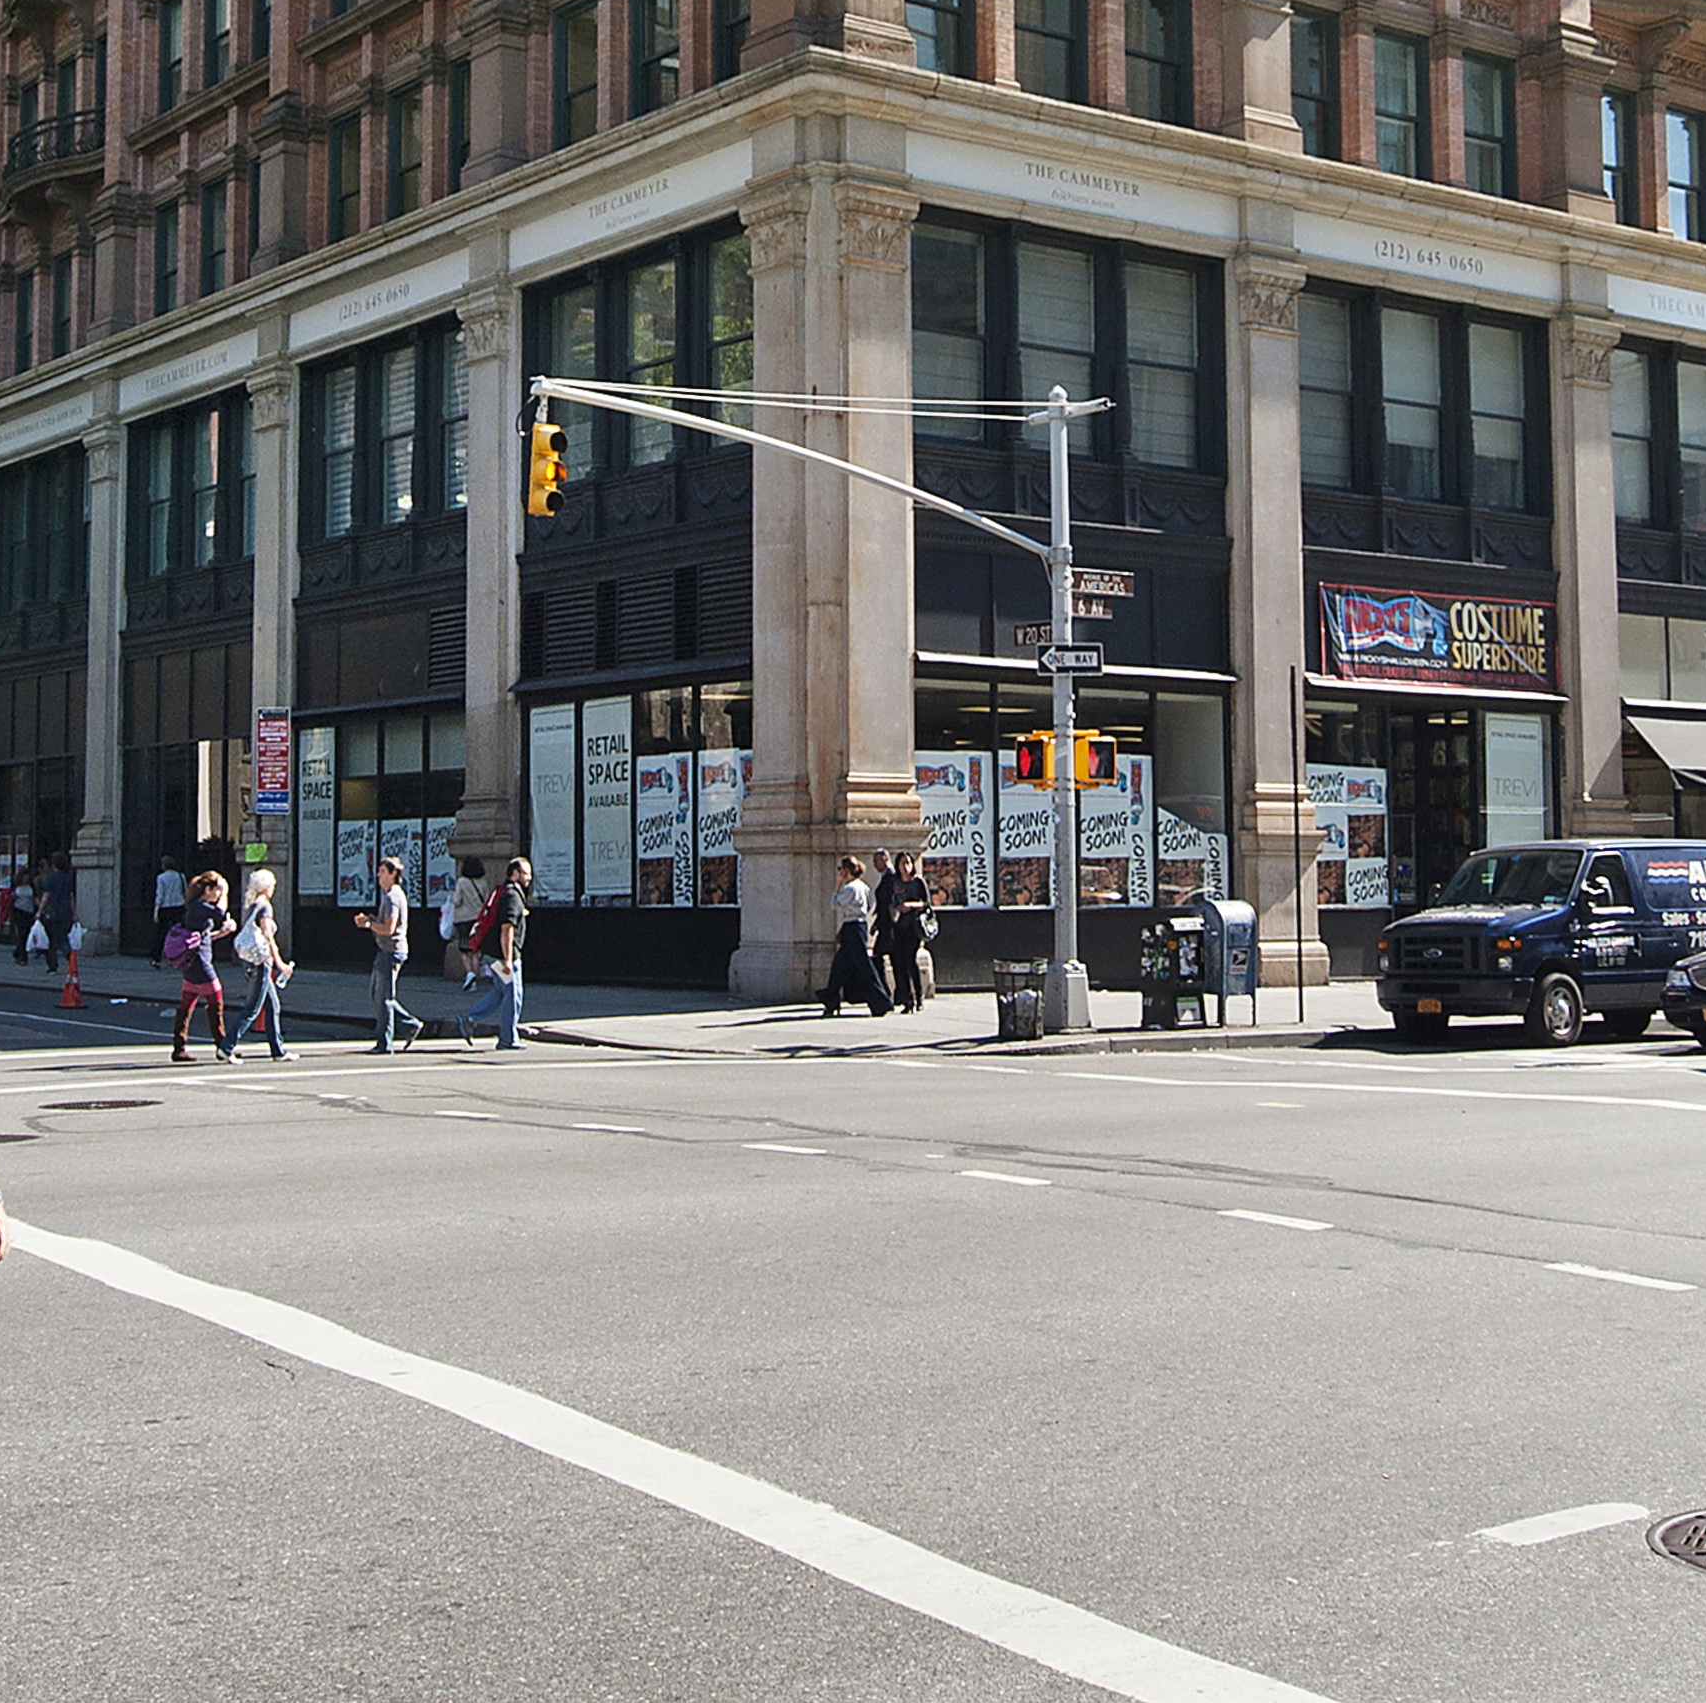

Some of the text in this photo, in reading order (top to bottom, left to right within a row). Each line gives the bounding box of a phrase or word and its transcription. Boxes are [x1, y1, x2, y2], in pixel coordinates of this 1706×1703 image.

[1024, 162, 1140, 197] THE CAMMEYER
[1374, 240, 1411, 265] (212)
[1078, 579, 1126, 594] AMERICAS
[1078, 599, 1105, 616] 6 AV
[1016, 628, 1024, 645] W
[1025, 626, 1038, 644] 20
[1449, 601, 1545, 646] COSTUME
[1047, 653, 1094, 665] ONE WAY
[1451, 641, 1546, 673] SUPERSTORE
[587, 734, 629, 756] RETAIL
[302, 759, 332, 776] RETAIL
[588, 761, 629, 785] SPACE
[302, 781, 332, 801] SPACE
[1493, 777, 1537, 797] TREVI
[587, 793, 629, 808] AVAILABLE
[638, 811, 674, 837] COMING
[699, 807, 737, 833] COMING
[999, 809, 1050, 833] COMING
[1079, 811, 1129, 834] COMING
[642, 828, 673, 853] SOON!
[929, 827, 965, 850] OON!
[1005, 827, 1048, 851] SOON!
[1086, 829, 1126, 852] SOON!
[1162, 830, 1201, 853] SOON!
[970, 830, 990, 905] COMING
[1131, 833, 1150, 905] COMING
[1207, 835, 1225, 901] COMING
[1348, 864, 1389, 888] COMING
[1353, 879, 1389, 903] SOON!
[1662, 911, 1690, 926] Sales
